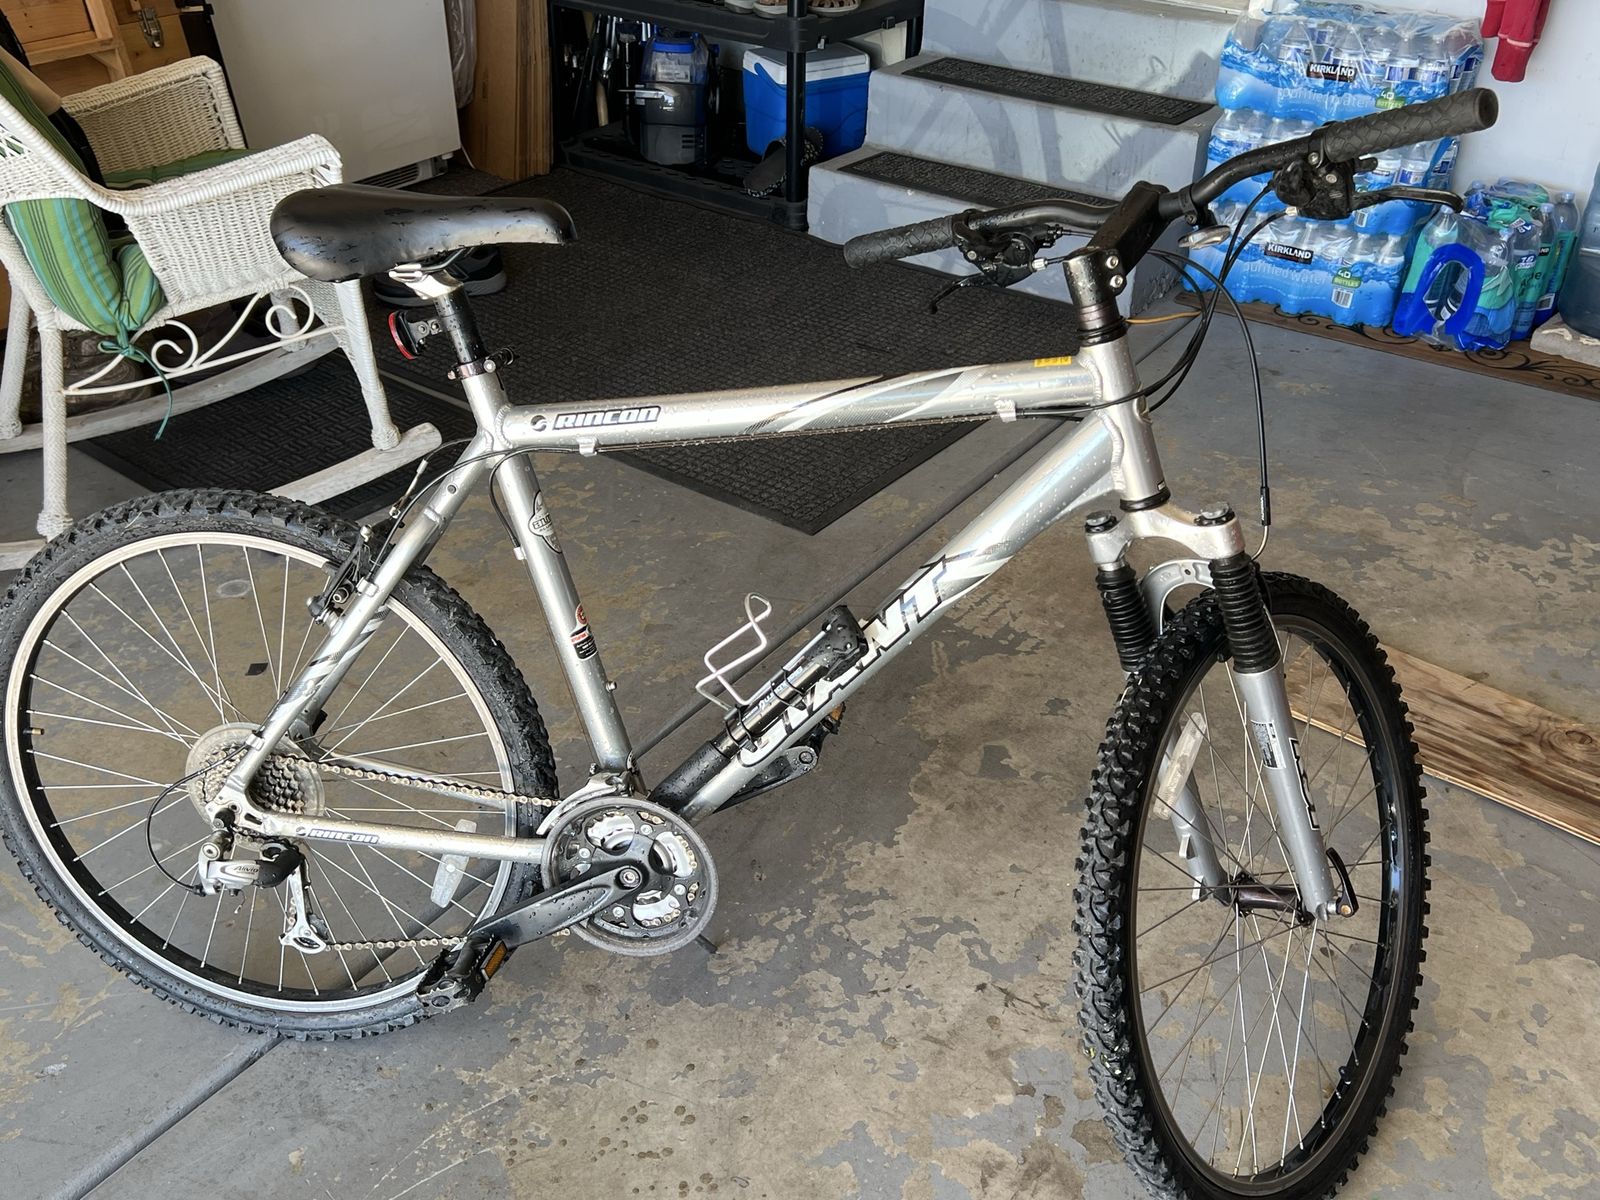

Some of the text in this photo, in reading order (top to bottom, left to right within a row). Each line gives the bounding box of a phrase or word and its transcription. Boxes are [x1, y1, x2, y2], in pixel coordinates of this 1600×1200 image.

[1309, 62, 1355, 78] KIRKLAND
[1267, 243, 1312, 260] KIRKLAND
[1337, 269, 1352, 279] 40
[554, 406, 661, 430] RINCON
[308, 828, 379, 844] RINCON
[233, 864, 259, 873] Alivio
